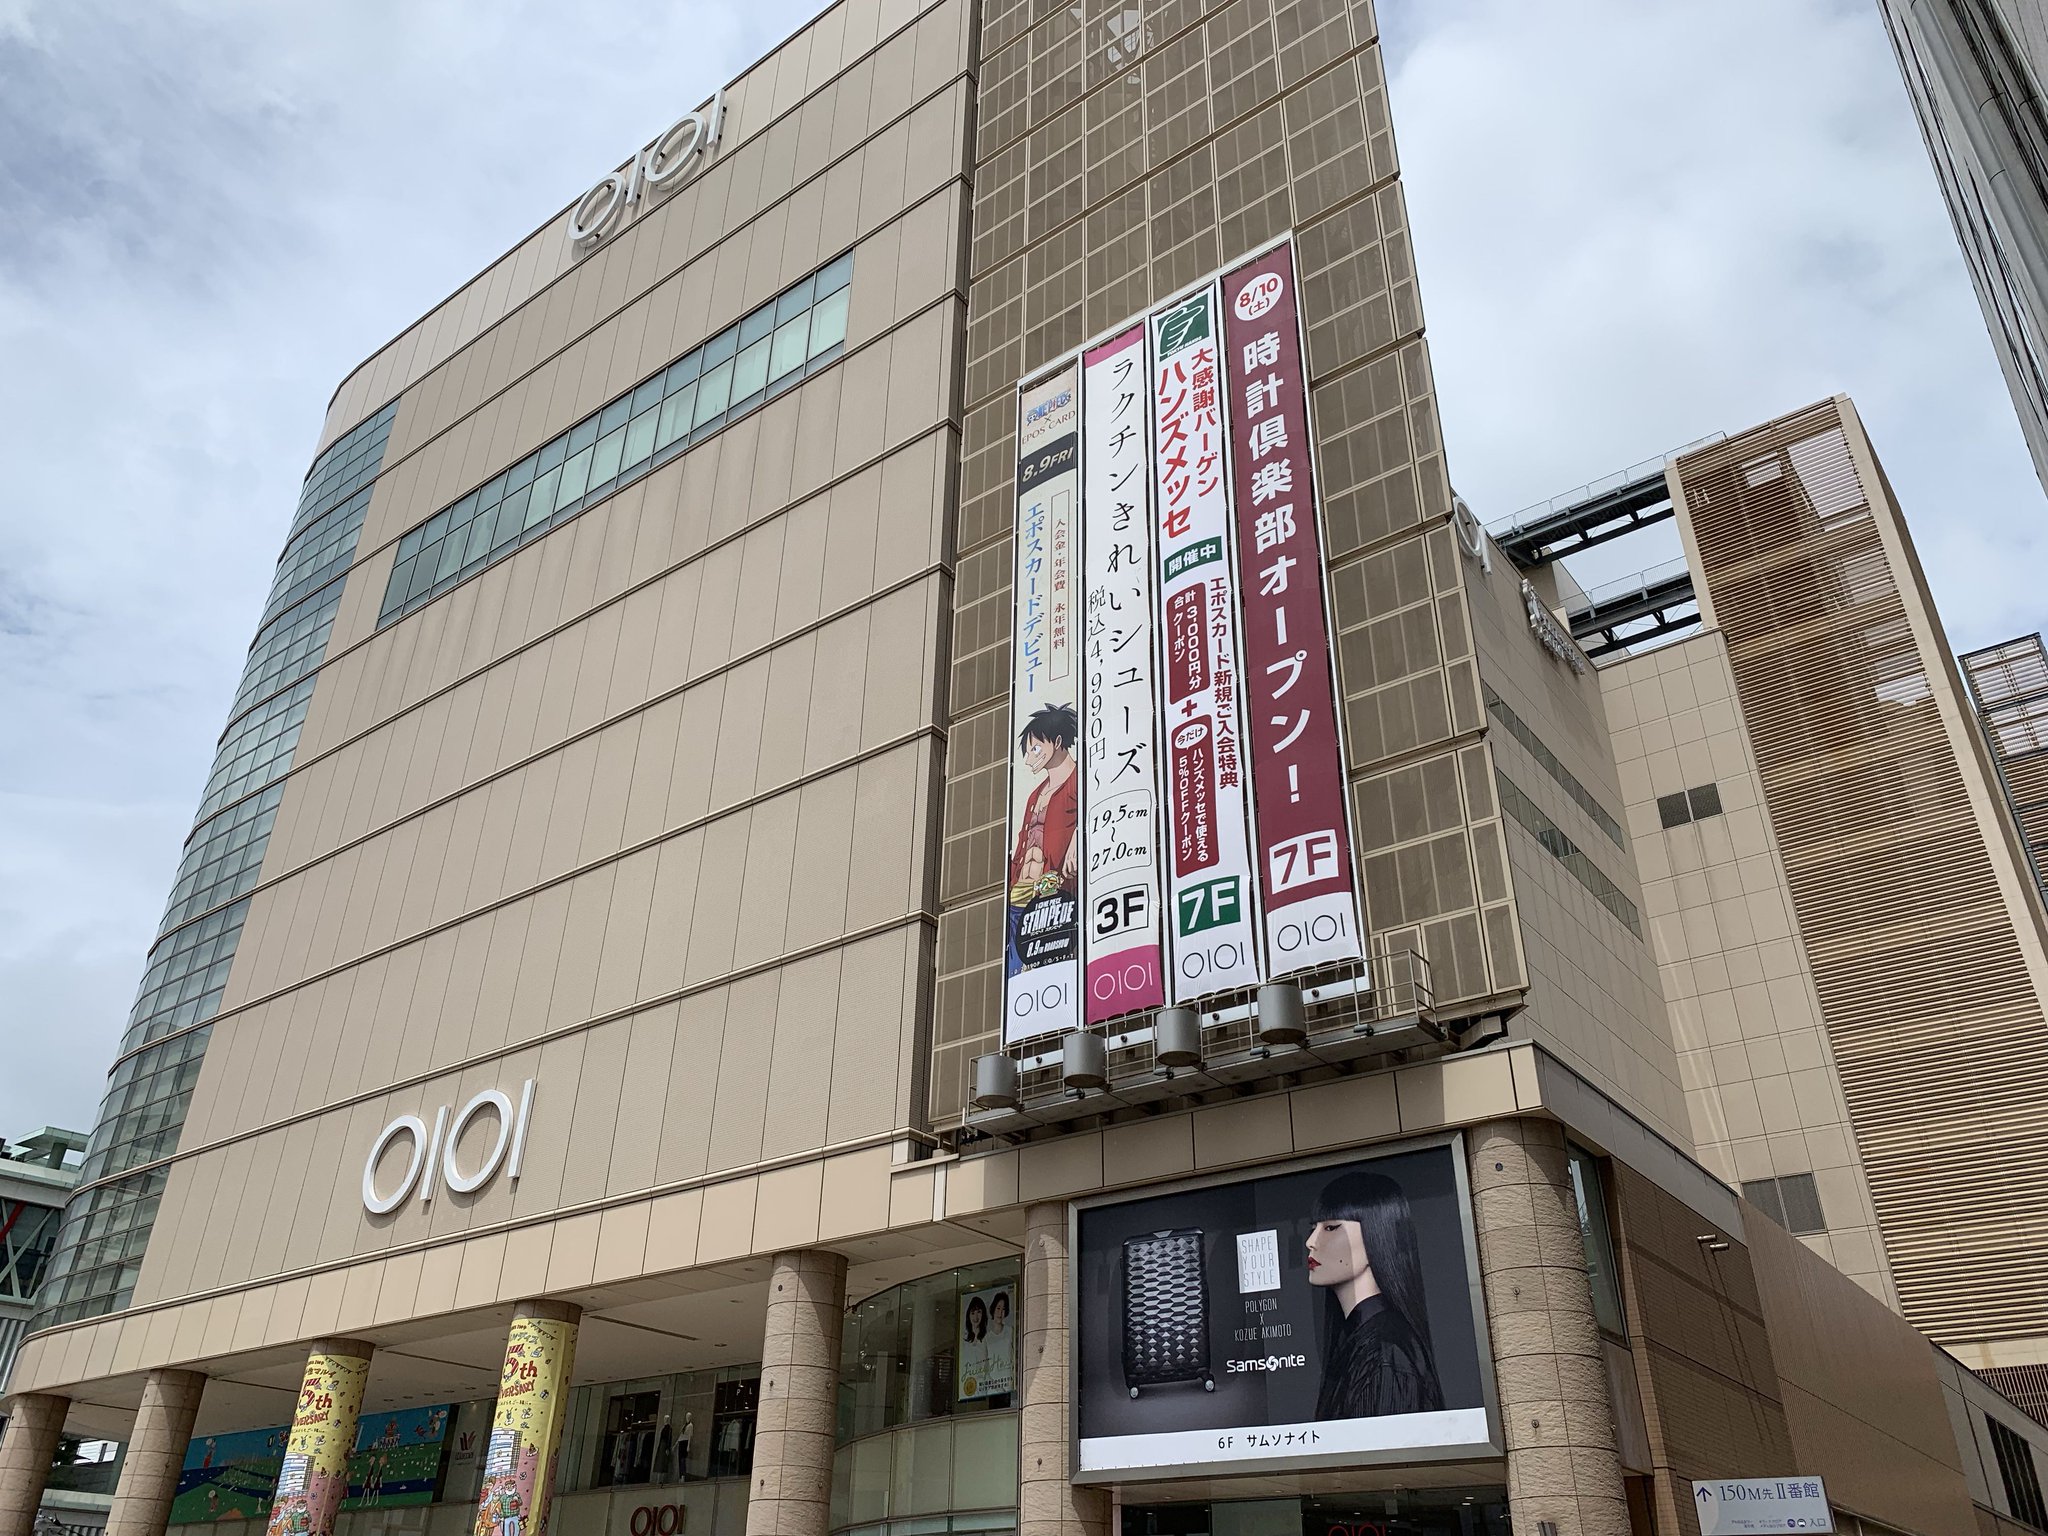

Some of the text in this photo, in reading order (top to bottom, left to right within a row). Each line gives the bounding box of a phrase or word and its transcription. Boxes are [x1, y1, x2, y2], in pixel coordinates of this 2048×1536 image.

[1240, 278, 1278, 308] 8/10
[1022, 410, 1076, 445] EPOS CARD
[1191, 347, 1218, 498] 大感謝バーゲン
[1158, 360, 1191, 539] ハンズメッセ
[1107, 358, 1148, 784] ラクチンきれいシューズ
[1168, 541, 1217, 576] 開催中
[1023, 502, 1045, 692] エポスカードデビュー
[1173, 590, 1196, 609] 合計
[1173, 611, 1186, 663] クーポン
[1210, 576, 1239, 790] エポスカード新規ご入会特典
[1177, 726, 1204, 745] 今だけ
[1091, 804, 1148, 835] 19.5cm
[1192, 748, 1209, 862] ハンズメッセで使える
[1090, 842, 1148, 873] 27.0cm
[1274, 836, 1331, 886] 7F
[1021, 901, 1075, 936] STAMPEDE
[1096, 889, 1146, 935] 3F
[1182, 881, 1235, 930] 7F
[1241, 1236, 1273, 1254] SHAPE
[1242, 1252, 1275, 1271] YOUR
[1243, 1268, 1275, 1288] STYLE
[1245, 1298, 1278, 1313] POLYGON
[1234, 1323, 1292, 1342] KOZUE AKIMOTO
[1226, 1353, 1306, 1374] Samsonite
[1218, 1430, 1320, 1449] 6F サムソナイト
[1809, 1518, 1827, 1527] 入口
